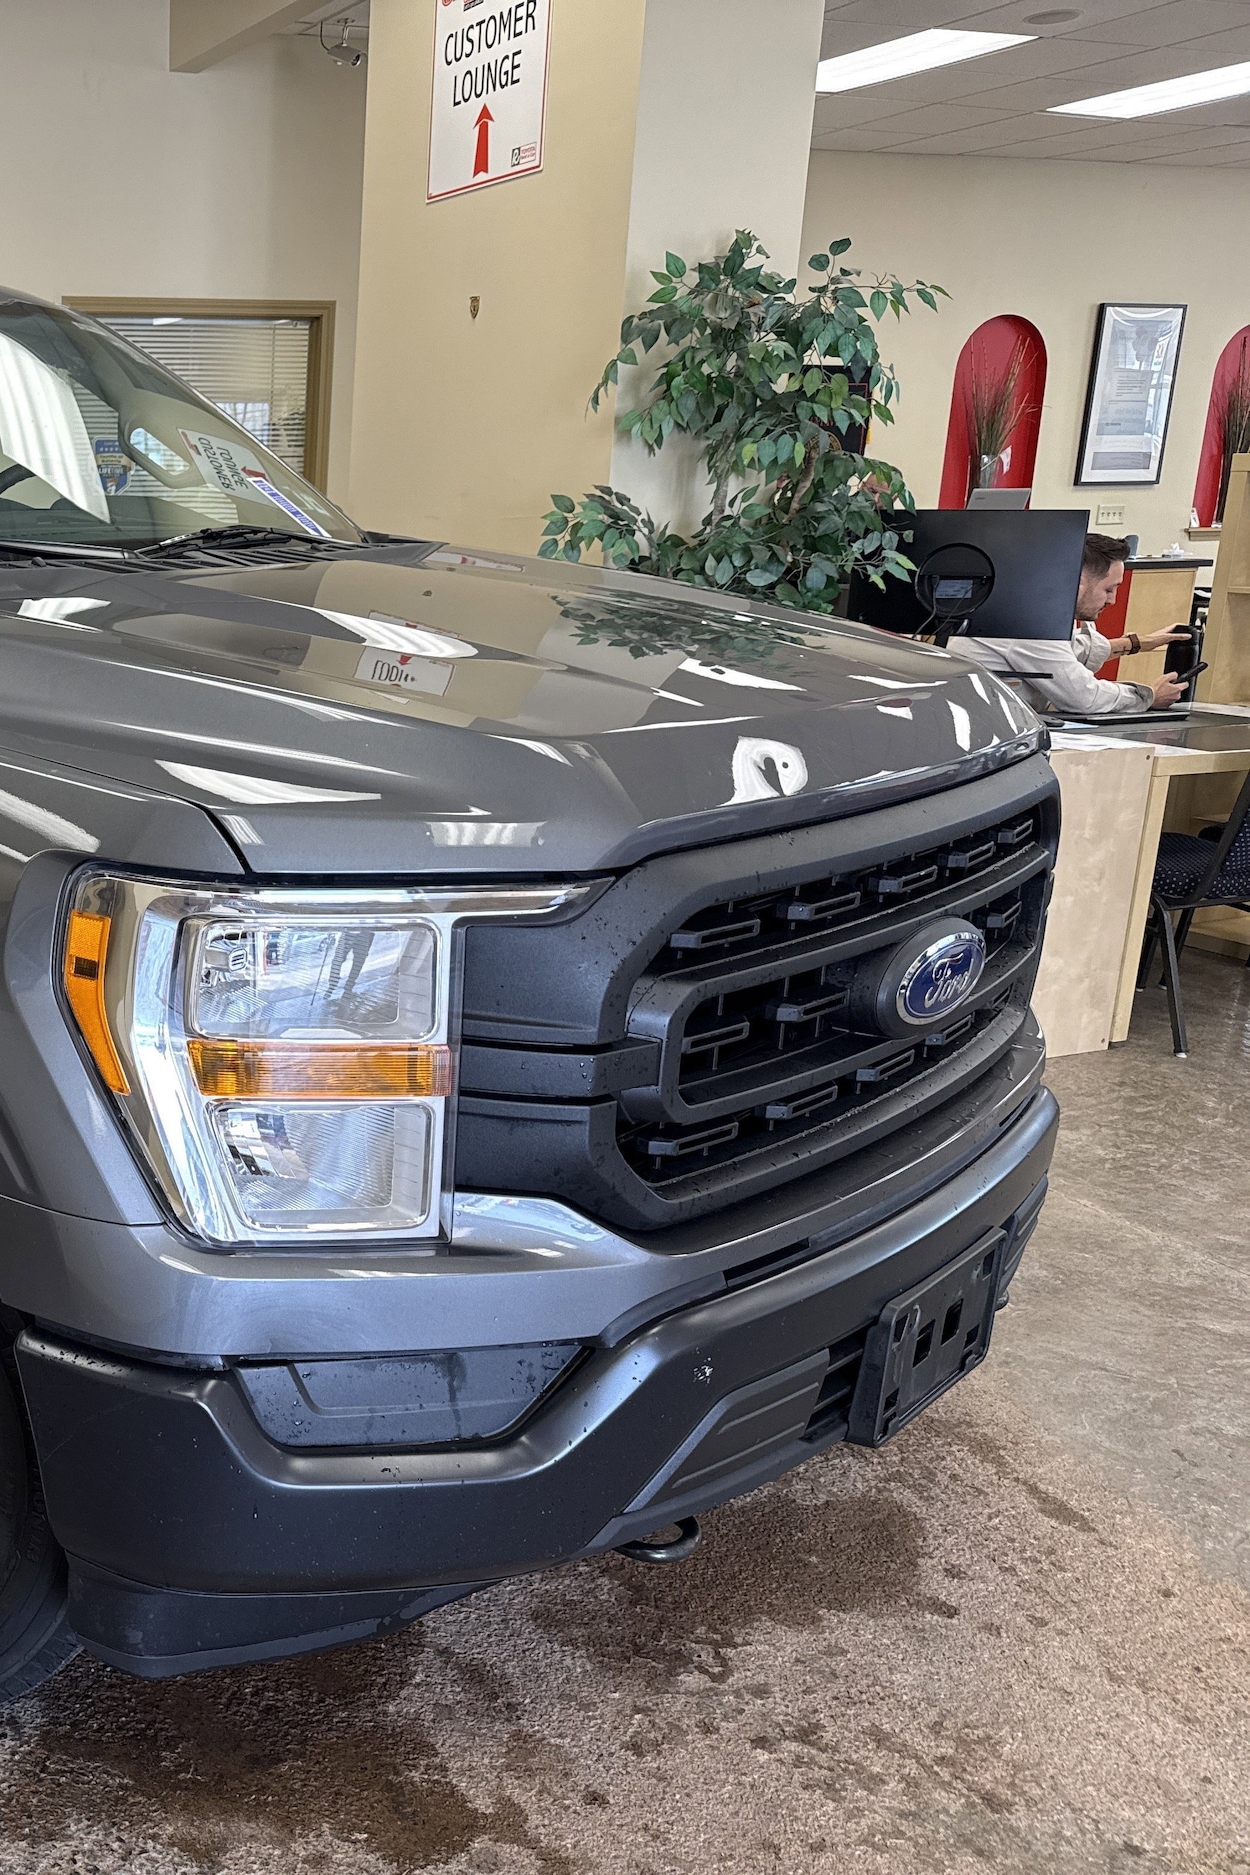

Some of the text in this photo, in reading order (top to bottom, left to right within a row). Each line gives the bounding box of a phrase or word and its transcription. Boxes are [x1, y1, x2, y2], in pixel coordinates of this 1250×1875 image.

[444, 0, 537, 66] CUSTOMER
[452, 49, 522, 107] LOUNGE
[924, 952, 974, 1009] Ford
